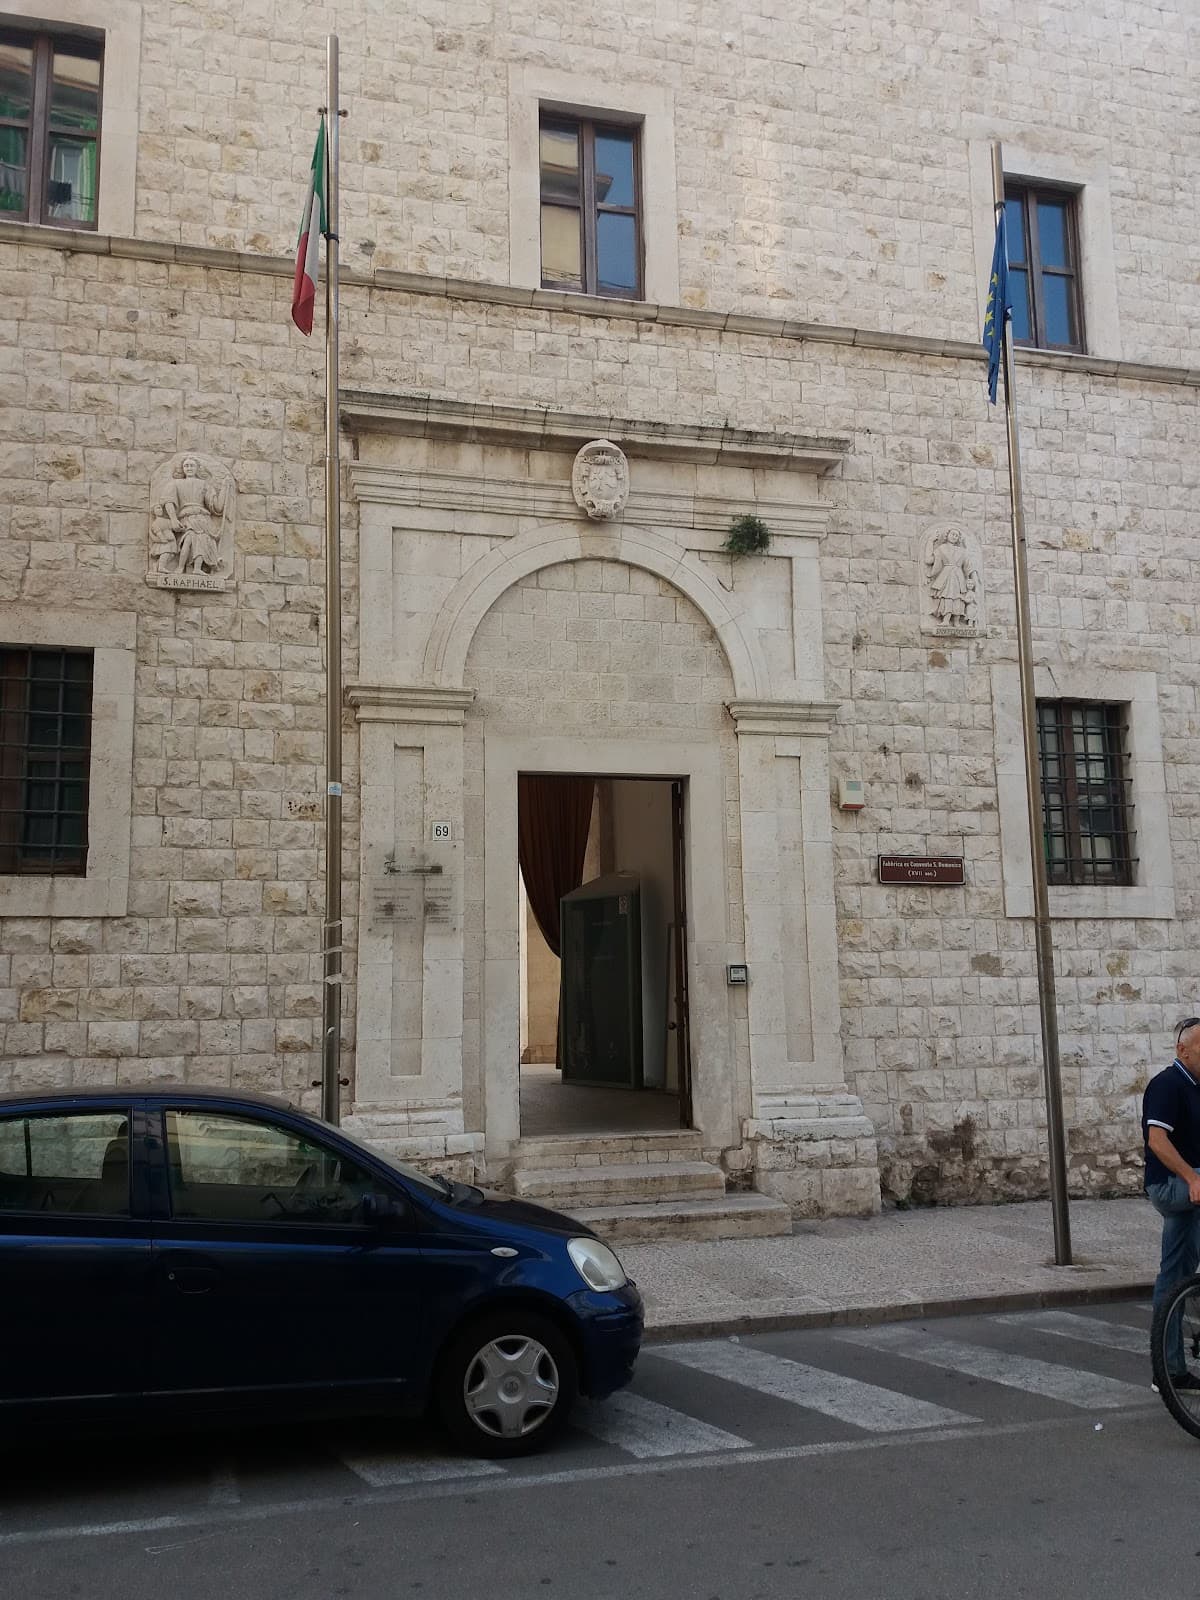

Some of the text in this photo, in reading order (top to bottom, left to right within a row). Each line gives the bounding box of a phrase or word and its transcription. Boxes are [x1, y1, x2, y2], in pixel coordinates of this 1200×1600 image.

[162, 577, 219, 589] S. RAPHAEL
[435, 825, 449, 837] 69
